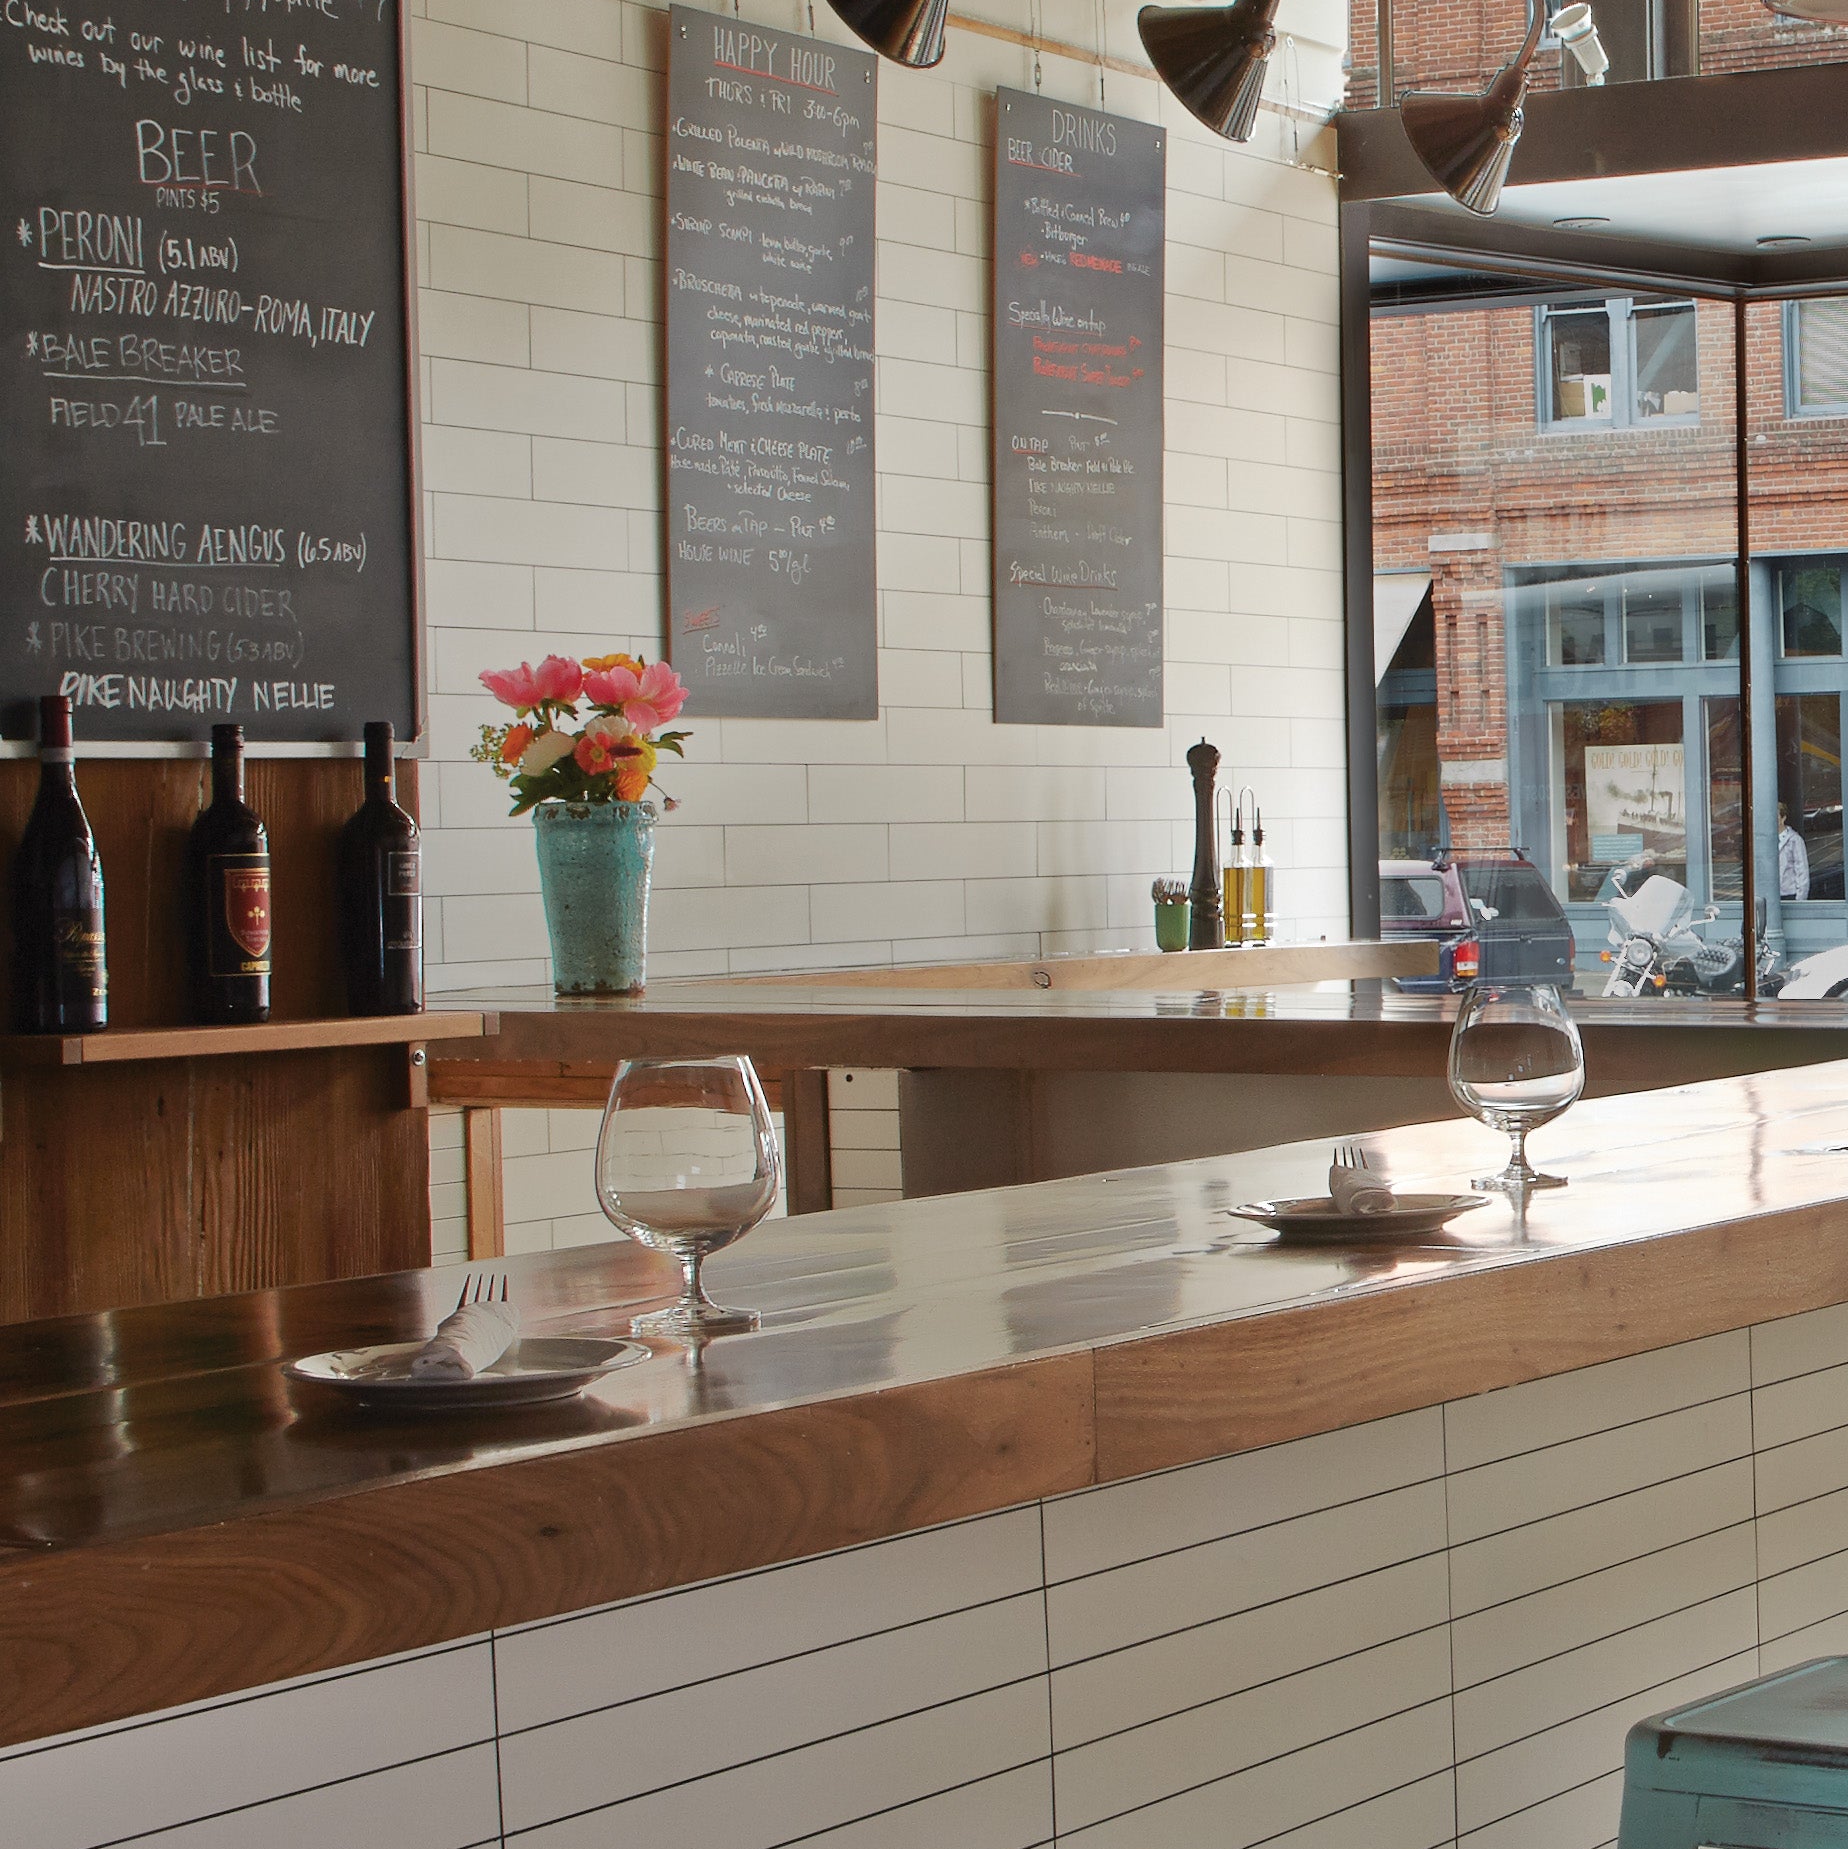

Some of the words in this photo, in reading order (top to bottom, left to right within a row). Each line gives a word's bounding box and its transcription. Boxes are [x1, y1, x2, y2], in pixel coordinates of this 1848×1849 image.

[28, 42, 85, 68] wines
[100, 51, 127, 88] by
[134, 56, 169, 84] the
[174, 68, 225, 106] glass
[250, 76, 303, 113] bottle
[81, 16, 117, 44] out
[130, 31, 163, 51] our
[178, 34, 227, 68] wine
[242, 36, 282, 73] list
[293, 44, 325, 77] for
[333, 63, 380, 88] more
[714, 26, 778, 75] HAPPY
[791, 48, 836, 90] HOUR
[705, 77, 753, 105] THURS
[769, 88, 791, 114] FRI
[136, 119, 262, 197] BEER
[1008, 137, 1033, 164] BEER
[1041, 147, 1073, 172] CIDER
[1052, 109, 1117, 156] DRINKS
[156, 187, 195, 210] PINTS
[199, 191, 220, 214] $5
[38, 206, 145, 267] PERONI
[159, 230, 195, 274] (5.1
[200, 237, 239, 273] ABV)
[70, 274, 158, 318] NASTRO
[320, 307, 375, 347] ITALY
[41, 333, 110, 371] BALE
[120, 334, 243, 378] BREAKER
[50, 396, 120, 427] FIELD
[123, 394, 167, 446] 41
[175, 400, 226, 428] PALE
[231, 408, 280, 434] ALE
[44, 514, 187, 560] WANDERING
[197, 524, 286, 564] AENGUS
[333, 532, 367, 573] ABV)
[41, 567, 139, 613] CHERRY
[152, 580, 213, 615] HARD
[222, 586, 297, 622] CIDER
[50, 622, 106, 658] PIKE
[114, 627, 219, 662] BREWING
[60, 671, 124, 708] PIKE
[128, 675, 238, 713] NAUGHTY
